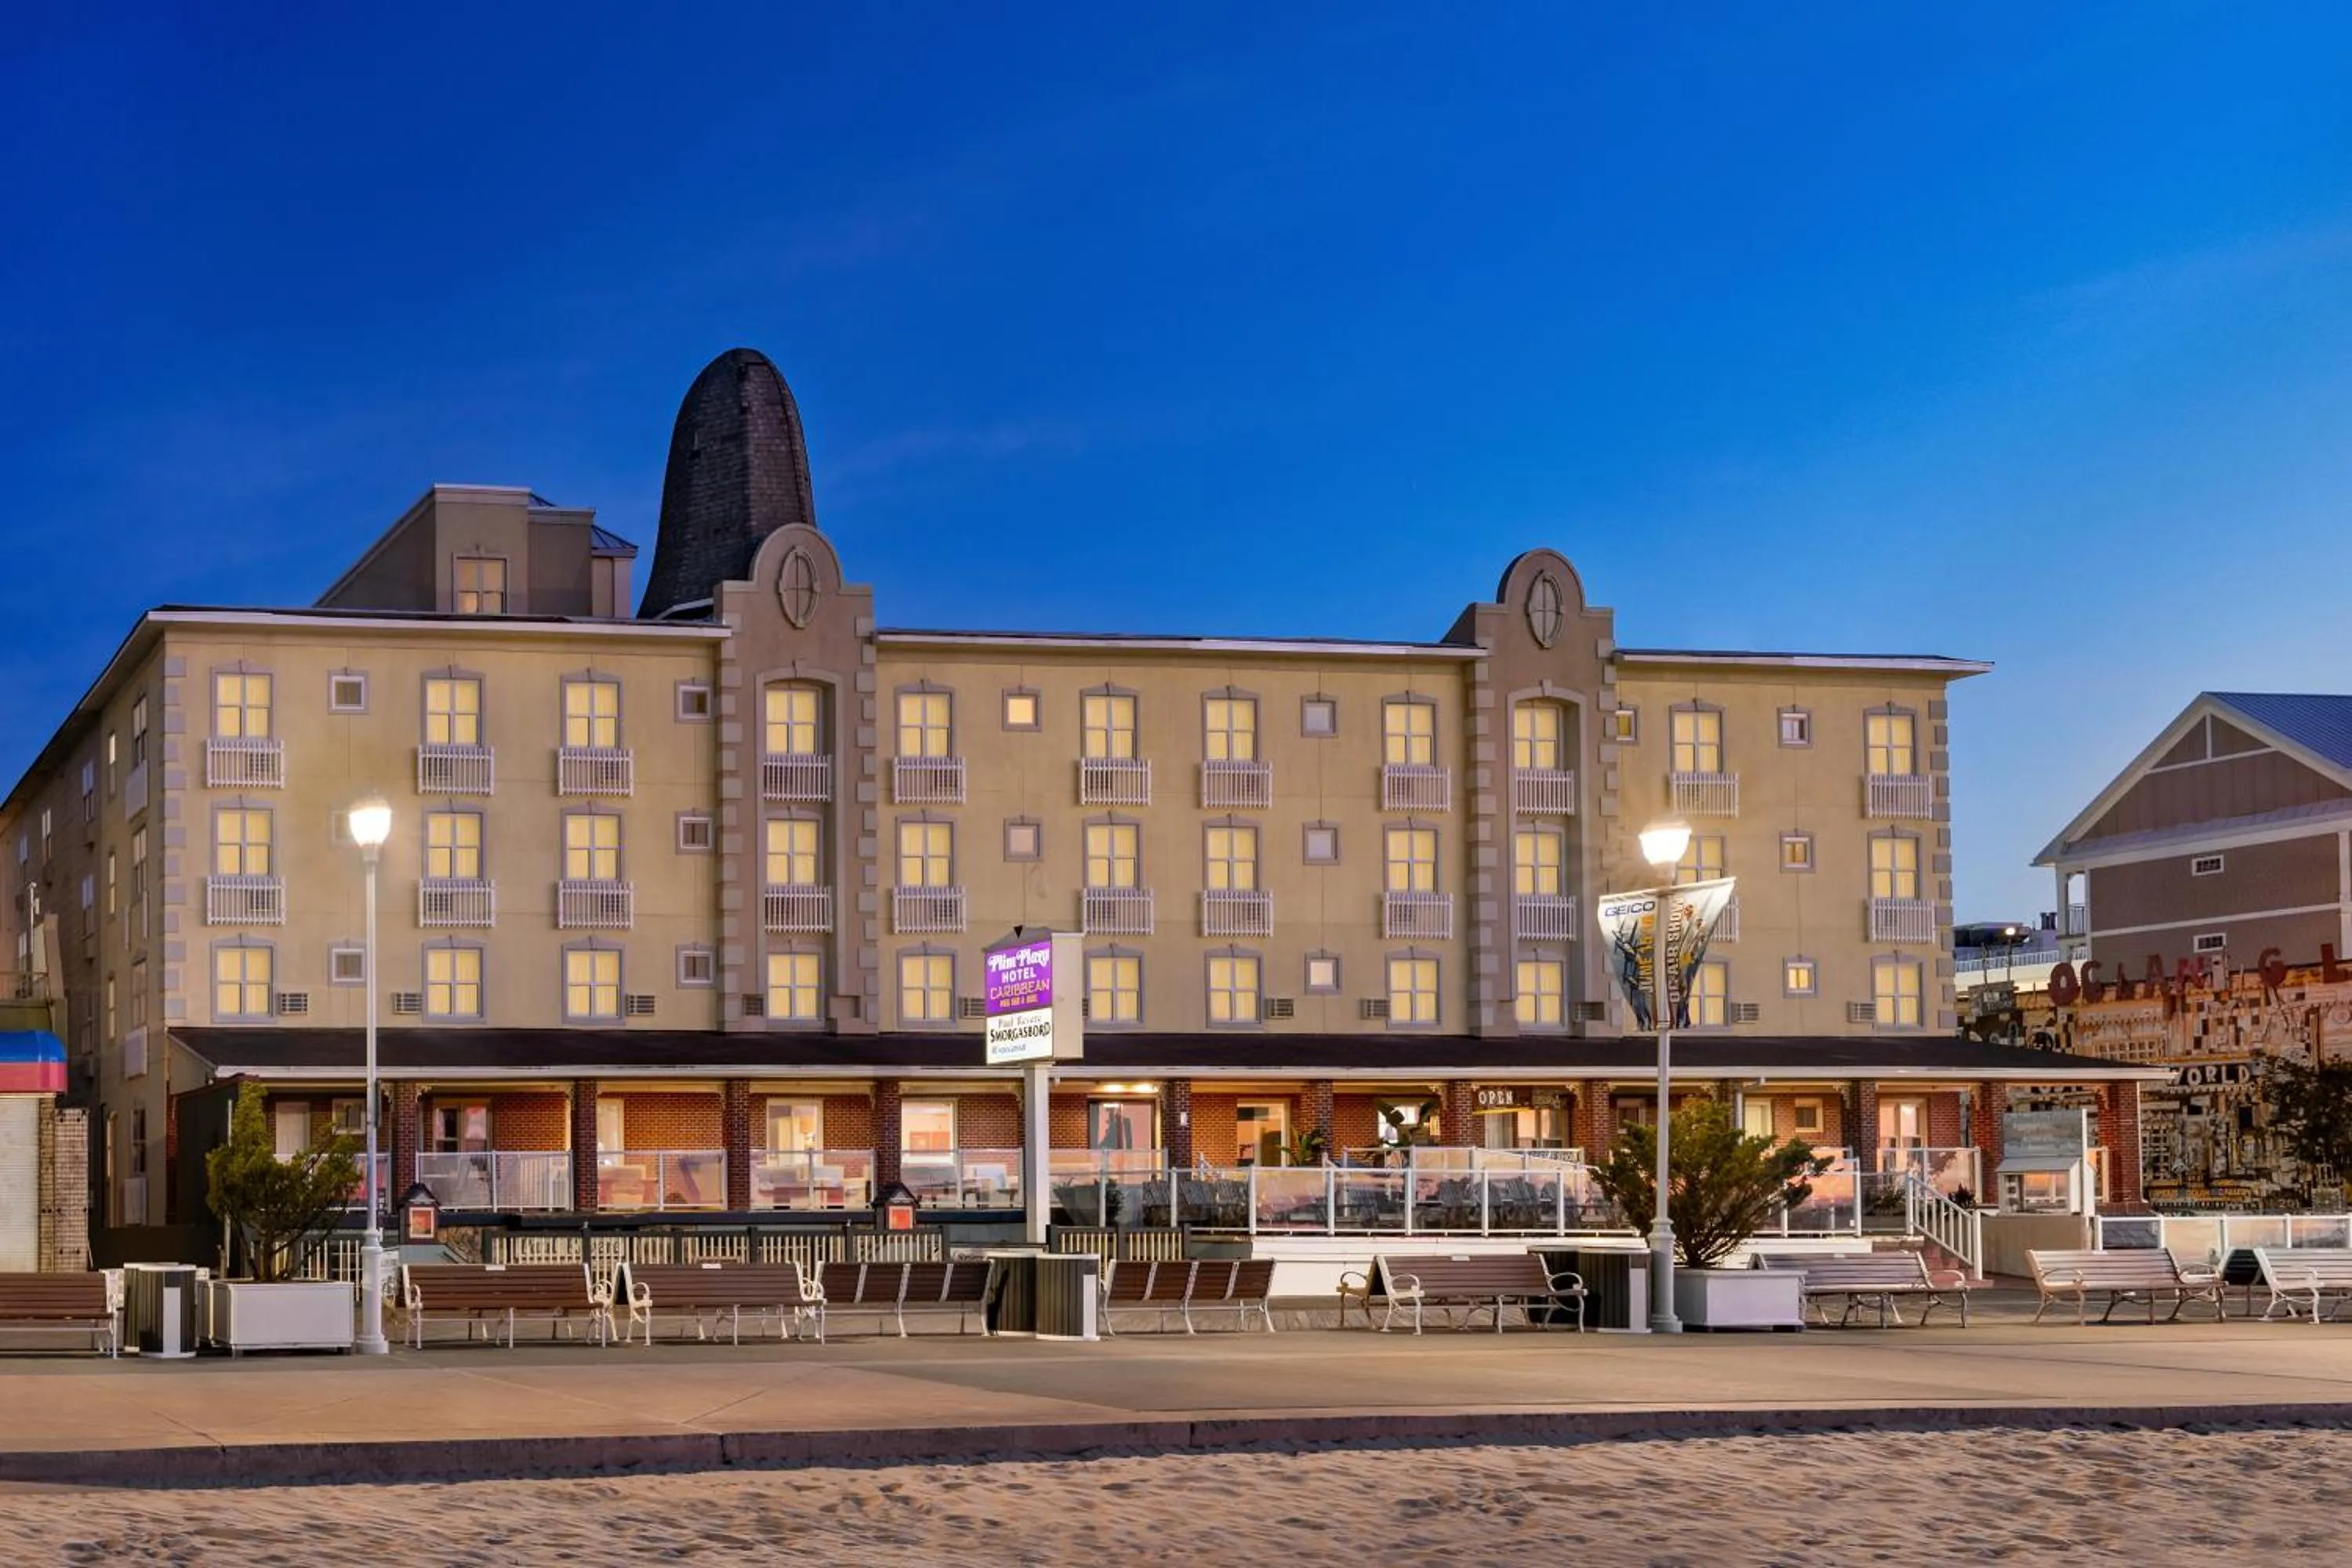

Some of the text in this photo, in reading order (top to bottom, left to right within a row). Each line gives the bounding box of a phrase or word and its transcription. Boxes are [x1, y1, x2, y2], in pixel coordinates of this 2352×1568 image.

[1605, 902, 1655, 916] GEICO
[1668, 898, 1684, 942] SHOW
[1668, 946, 1679, 975] AIR
[1001, 967, 1036, 983] HOTEL
[1639, 957, 1653, 993] JUNE
[990, 978, 1050, 1000] CARIBBEAN
[1478, 1091, 1514, 1105] OPEN
